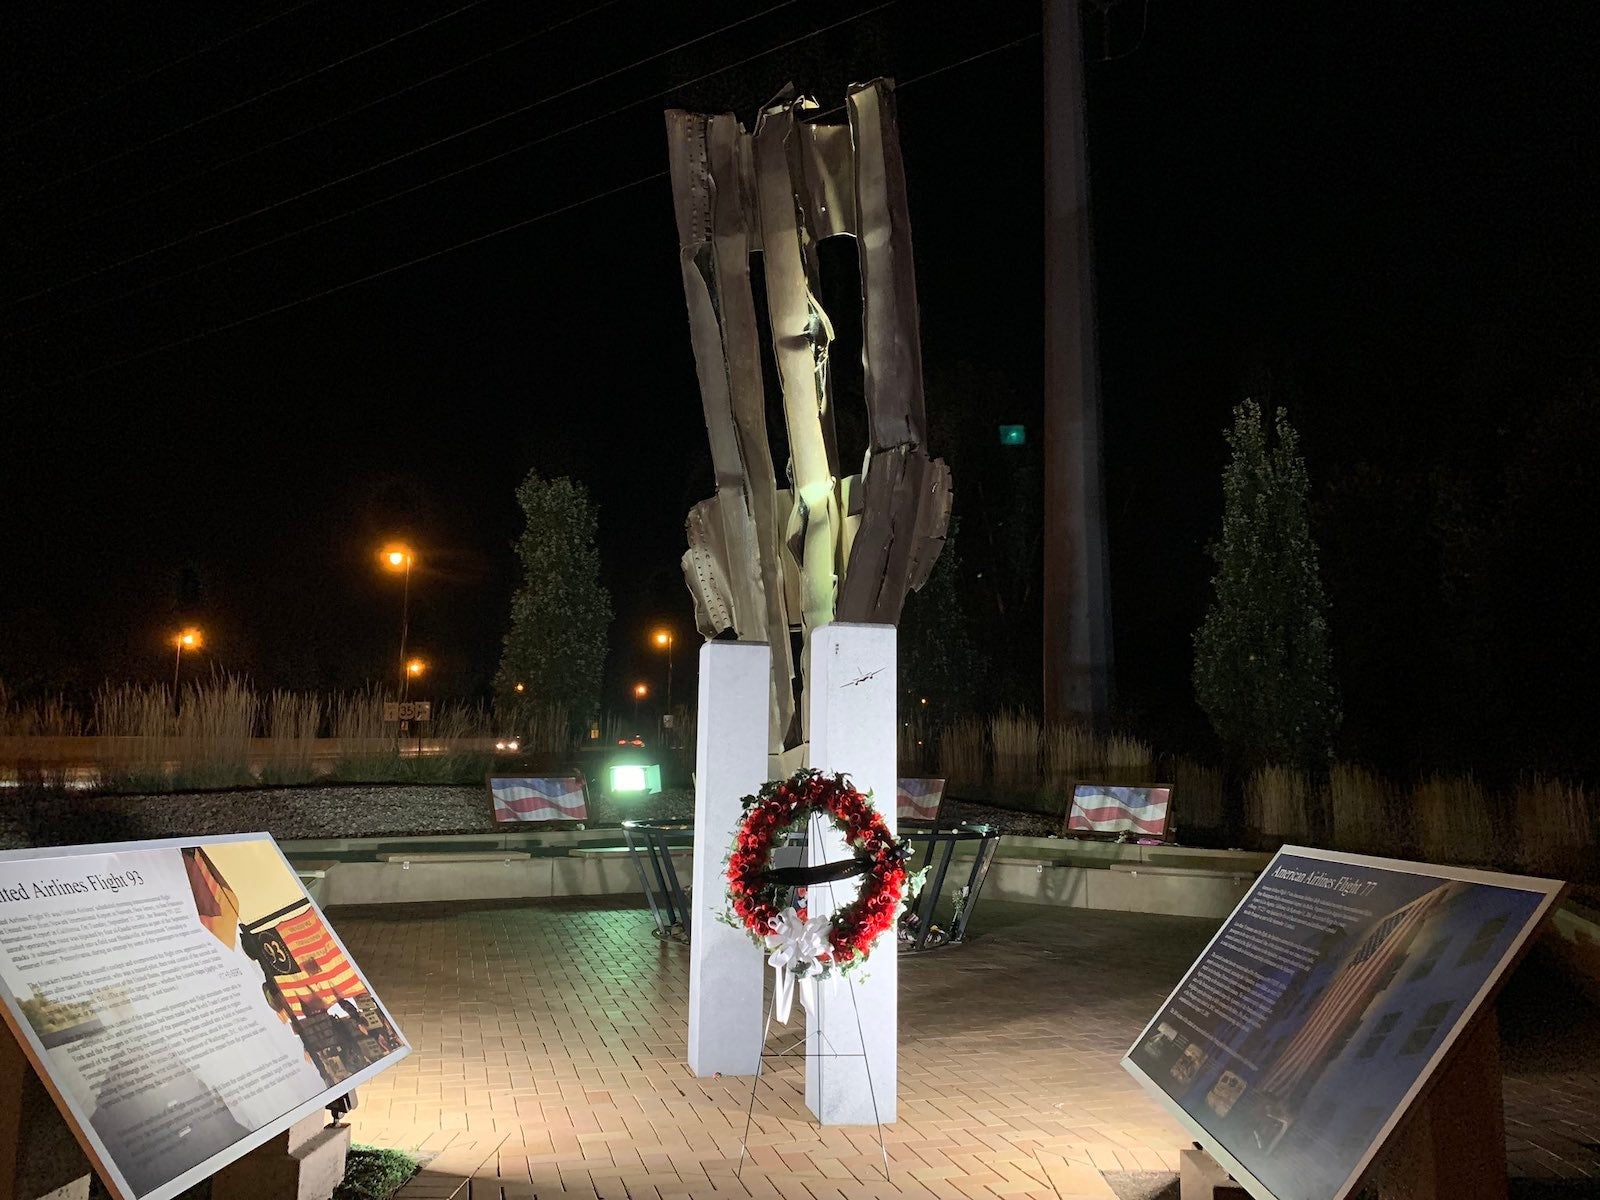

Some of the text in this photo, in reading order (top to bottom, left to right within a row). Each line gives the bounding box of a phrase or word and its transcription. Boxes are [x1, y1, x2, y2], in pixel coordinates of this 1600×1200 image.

[0, 870, 144, 903] ited Airlines Flight 93
[1271, 865, 1378, 897] American Airlines Flight 77
[264, 940, 286, 964] 93
